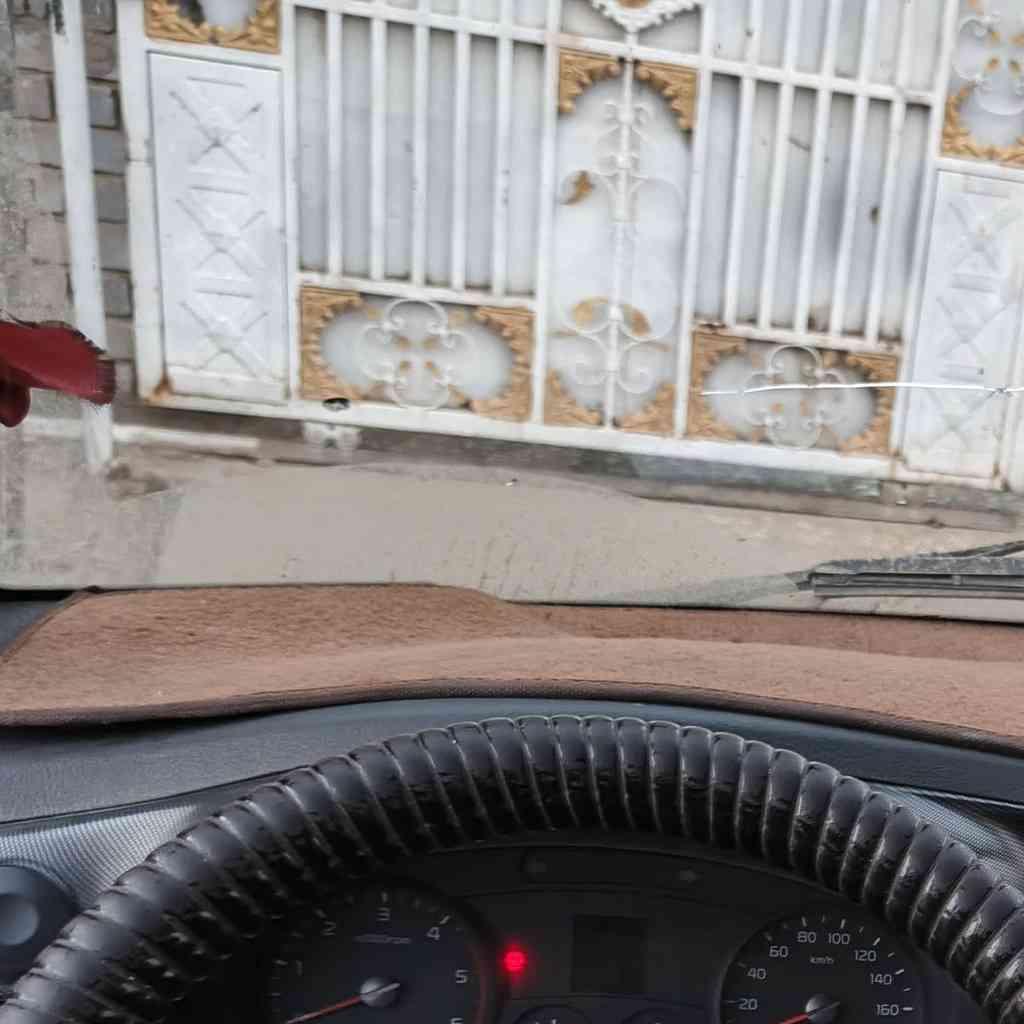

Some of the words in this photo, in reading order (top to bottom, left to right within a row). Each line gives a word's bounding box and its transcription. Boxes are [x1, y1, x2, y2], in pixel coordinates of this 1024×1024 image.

[426, 926, 440, 940] 4
[797, 931, 817, 943] 80
[828, 932, 850, 944] 100
[769, 946, 789, 958] 60
[855, 950, 877, 961] 120
[455, 969, 468, 983] 5
[748, 968, 767, 980] 40
[870, 973, 892, 985] 140
[739, 999, 758, 1010] 20
[877, 1004, 899, 1015] 160
